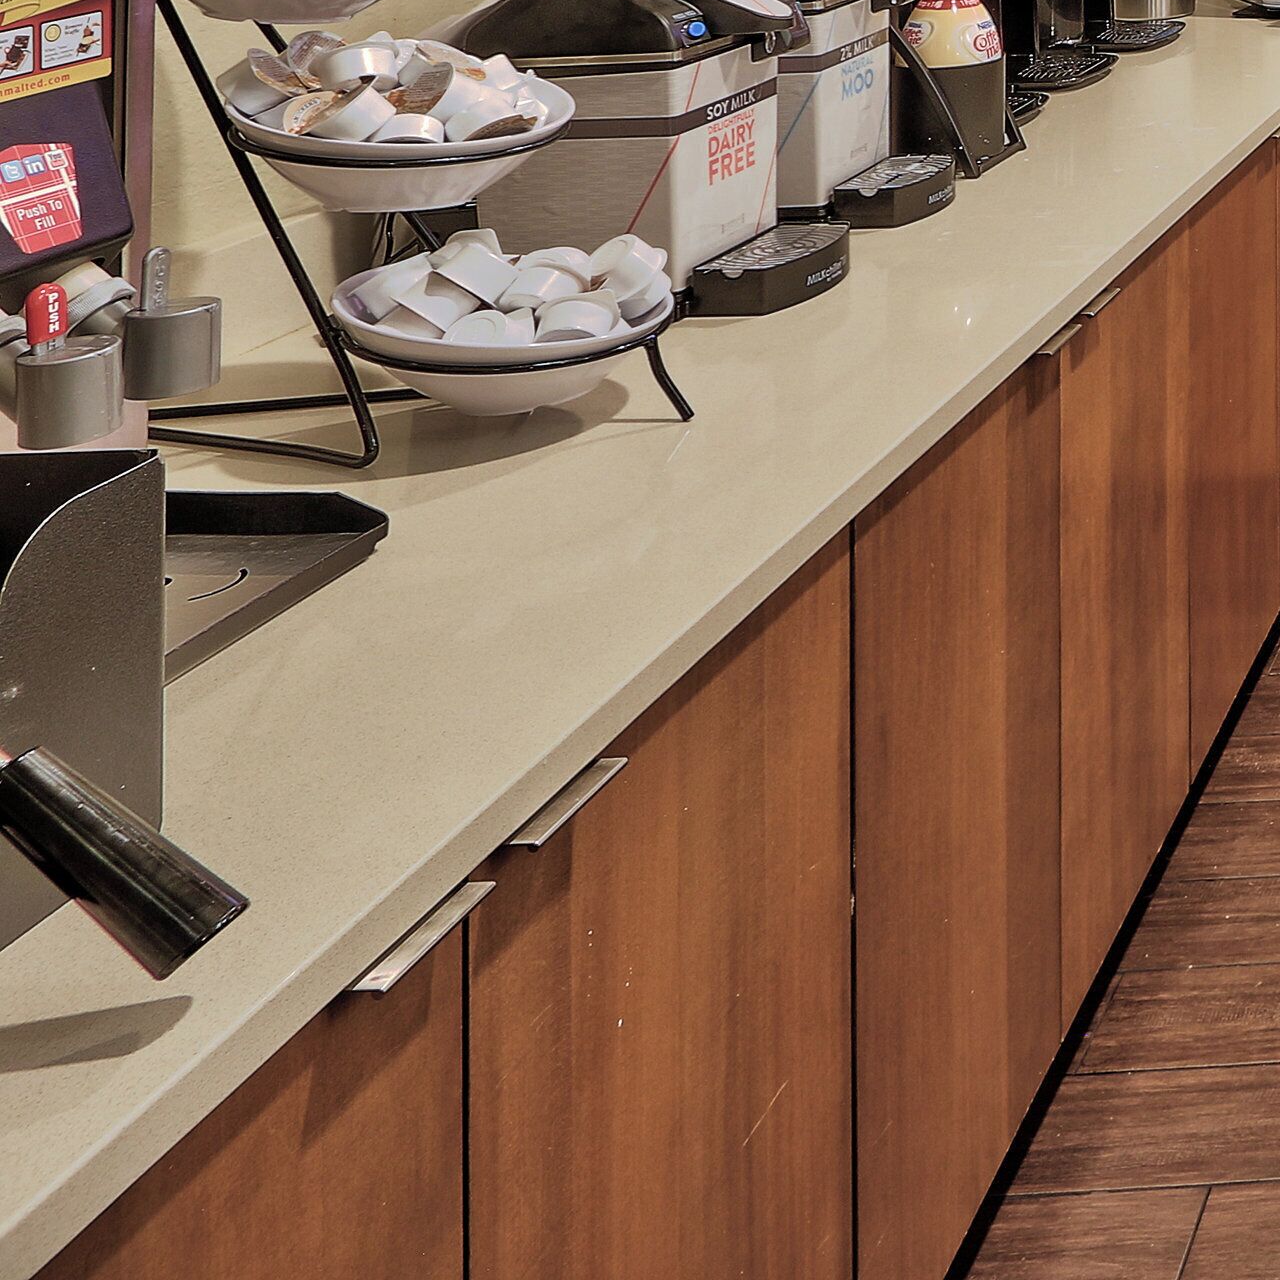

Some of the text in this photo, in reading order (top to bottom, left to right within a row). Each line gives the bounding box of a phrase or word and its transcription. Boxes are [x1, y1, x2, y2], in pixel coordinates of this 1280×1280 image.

[853, 35, 874, 55] MILK
[842, 68, 874, 101] MOO
[707, 89, 755, 120] SOY MILK
[708, 119, 755, 159] DAIRY
[709, 141, 755, 186] FREE
[17, 199, 63, 221] Push To
[34, 215, 56, 231] Fill
[48, 291, 60, 333] PUSH
